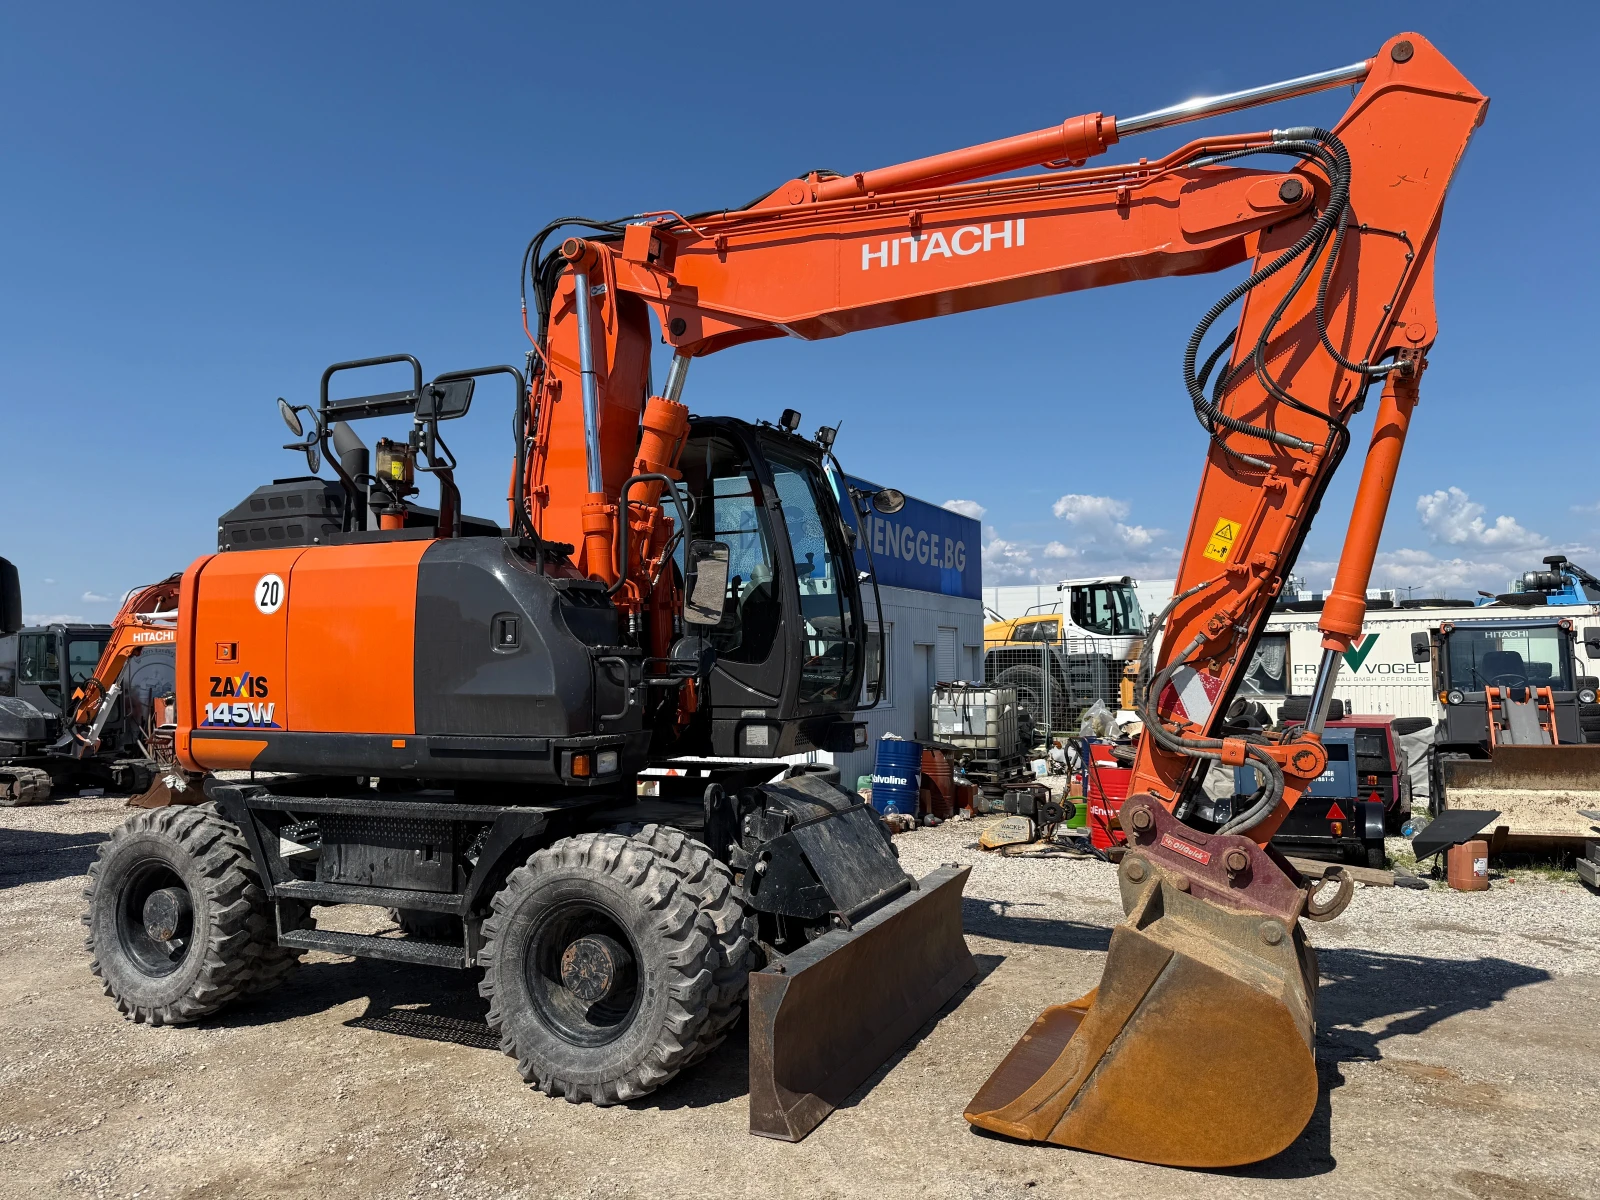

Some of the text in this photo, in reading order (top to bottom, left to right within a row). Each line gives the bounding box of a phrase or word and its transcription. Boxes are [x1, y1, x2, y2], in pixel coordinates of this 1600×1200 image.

[862, 219, 1025, 270] HITACHI
[260, 581, 279, 606] 20
[133, 631, 174, 642] HITACHI
[1484, 630, 1529, 639] HITACHI
[1294, 663, 1429, 675] FRZ VOGEL
[209, 672, 268, 698] ZAXIS
[204, 702, 275, 725] 145W
[1173, 842, 1204, 860] OilQuick
